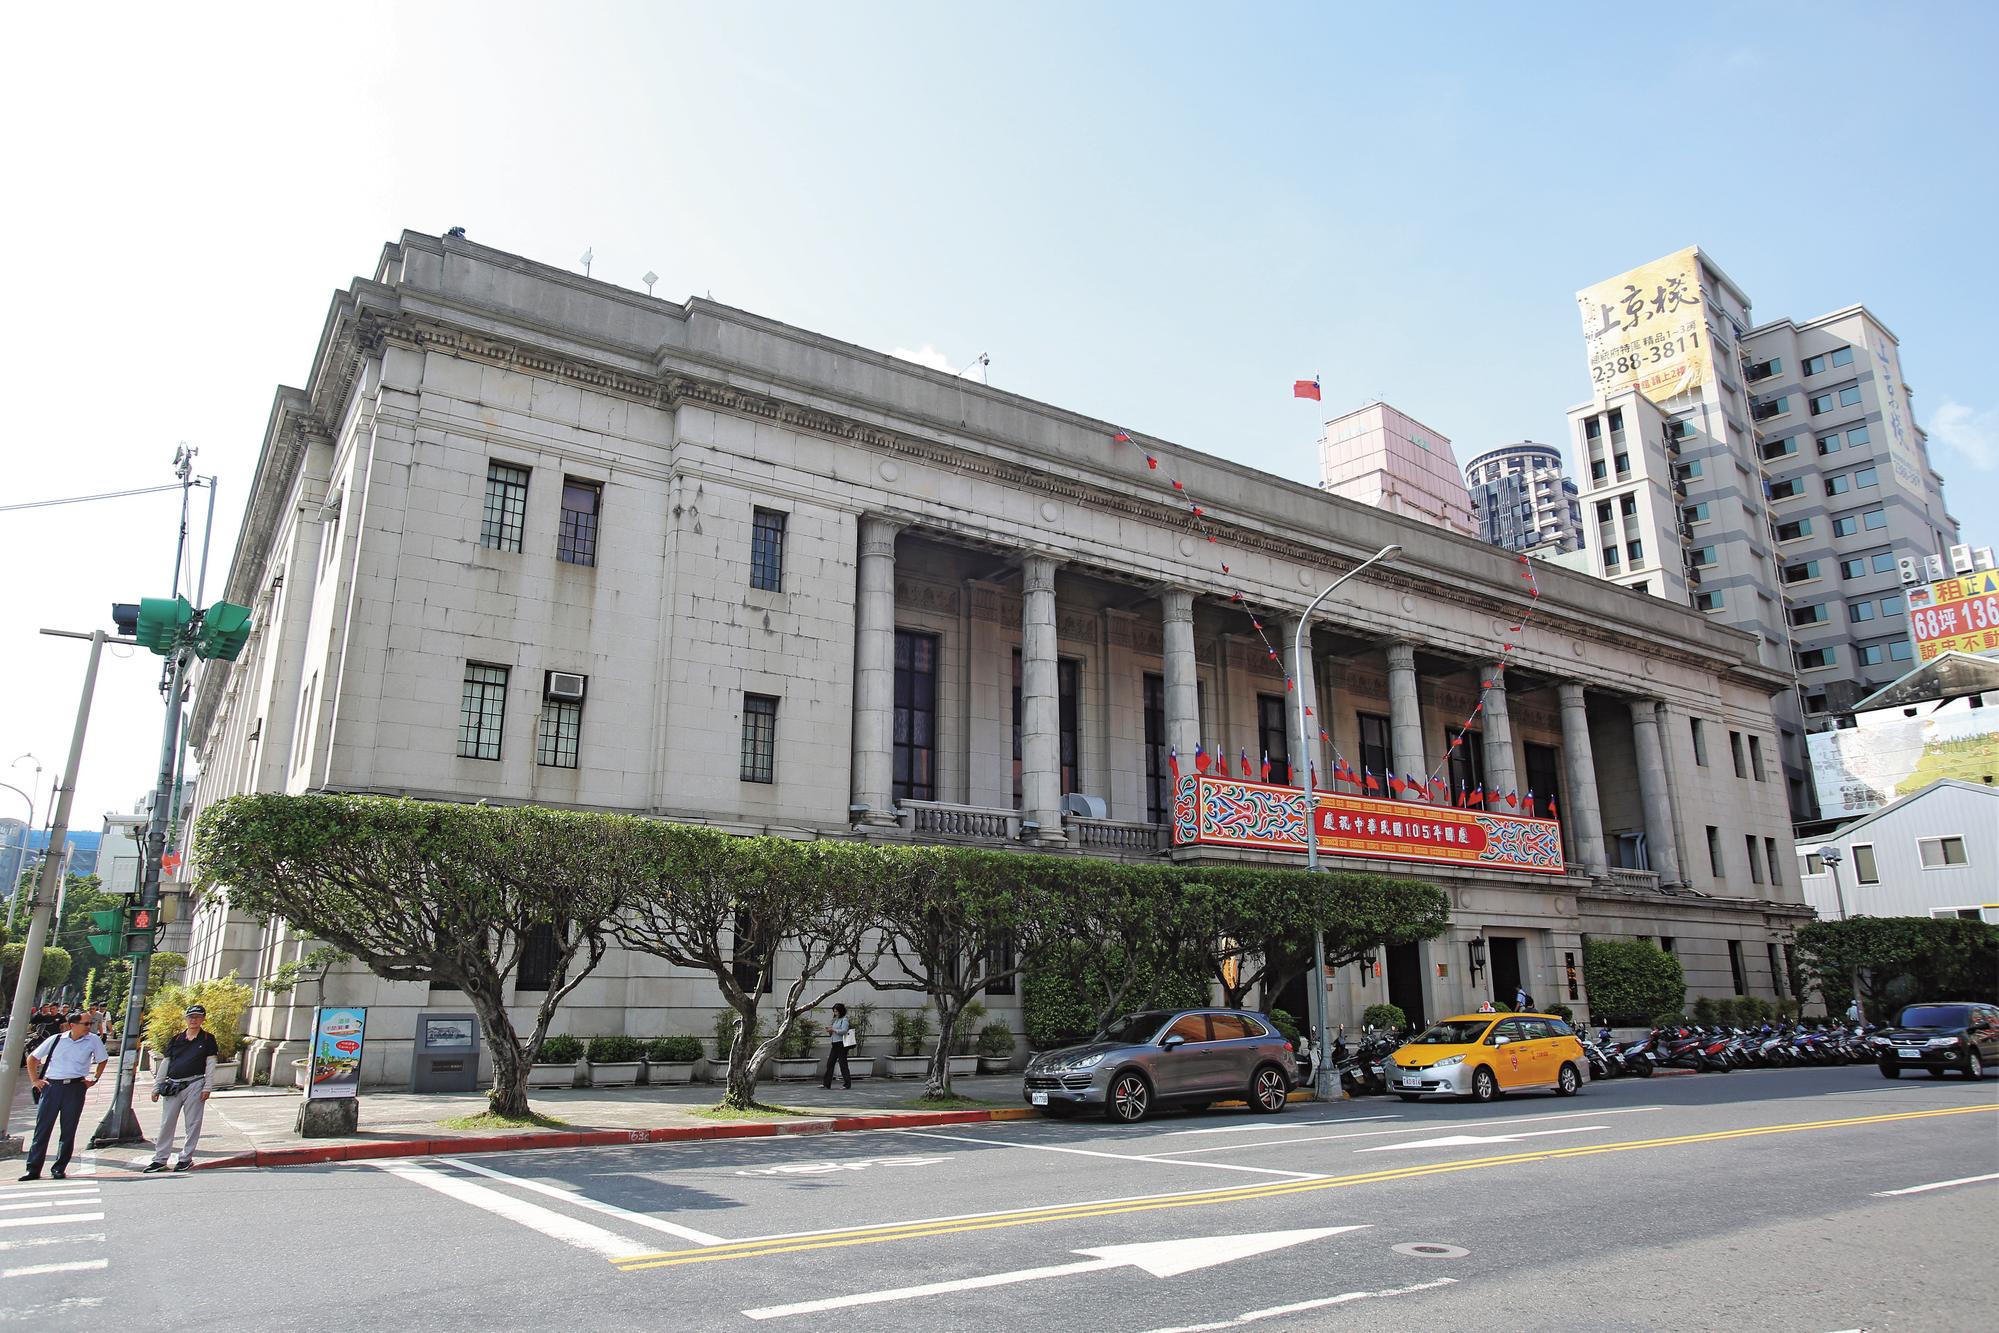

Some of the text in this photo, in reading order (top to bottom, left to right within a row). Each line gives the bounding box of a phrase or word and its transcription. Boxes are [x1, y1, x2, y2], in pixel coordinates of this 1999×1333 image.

[1593, 332, 1699, 383] 2388-3811
[1915, 608, 1957, 639] 68坪
[1323, 811, 1470, 844] 慶祝中華民國105年國慶
